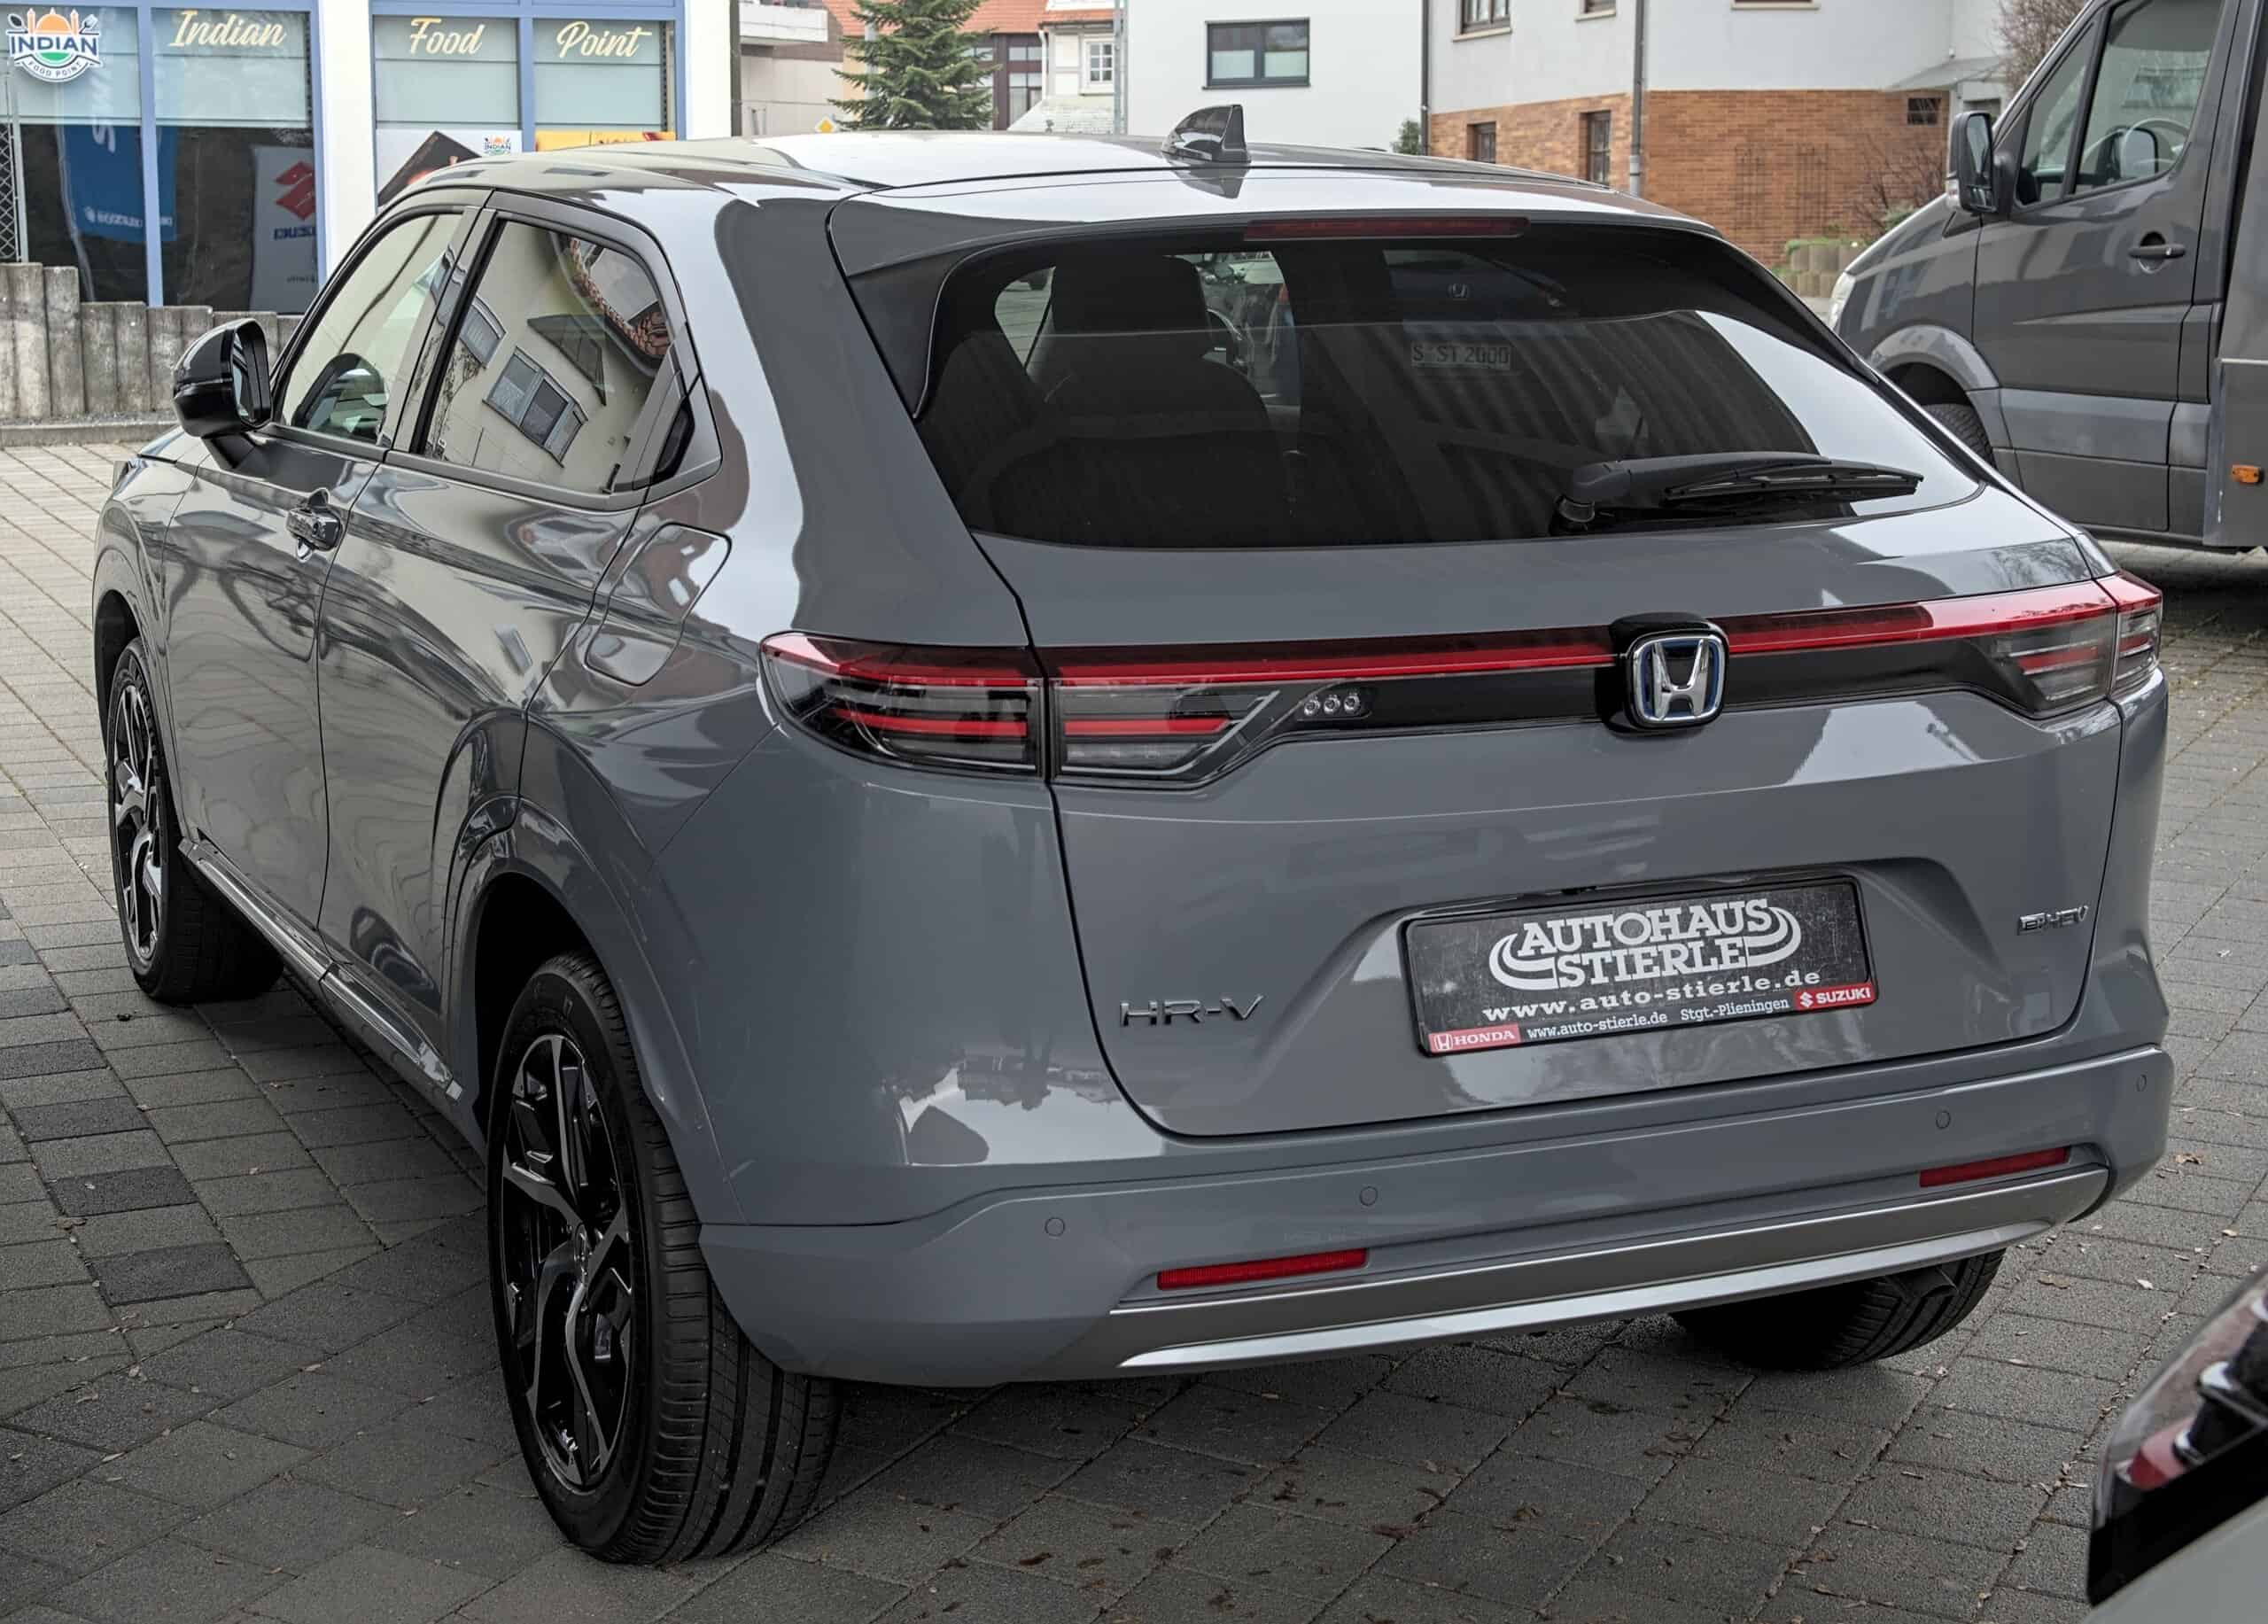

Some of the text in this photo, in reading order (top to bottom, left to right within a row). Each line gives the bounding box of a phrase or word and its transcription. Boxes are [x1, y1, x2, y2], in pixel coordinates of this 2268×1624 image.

[10, 35, 97, 56] INDIAN
[169, 9, 286, 48] Indian
[410, 17, 485, 57] Food
[556, 20, 653, 58] Point
[27, 60, 82, 77] FOOD POINT
[1516, 897, 1768, 957] AUTOHAUS
[1557, 938, 1745, 989] STIERLE
[1120, 993, 1264, 1027] HR-V
[1481, 968, 1821, 1022] www.auto-stierle.de
[1453, 987, 1872, 1045] HONDA www.auto-stierle.de Stgt.-Plieningen SUZUKI
